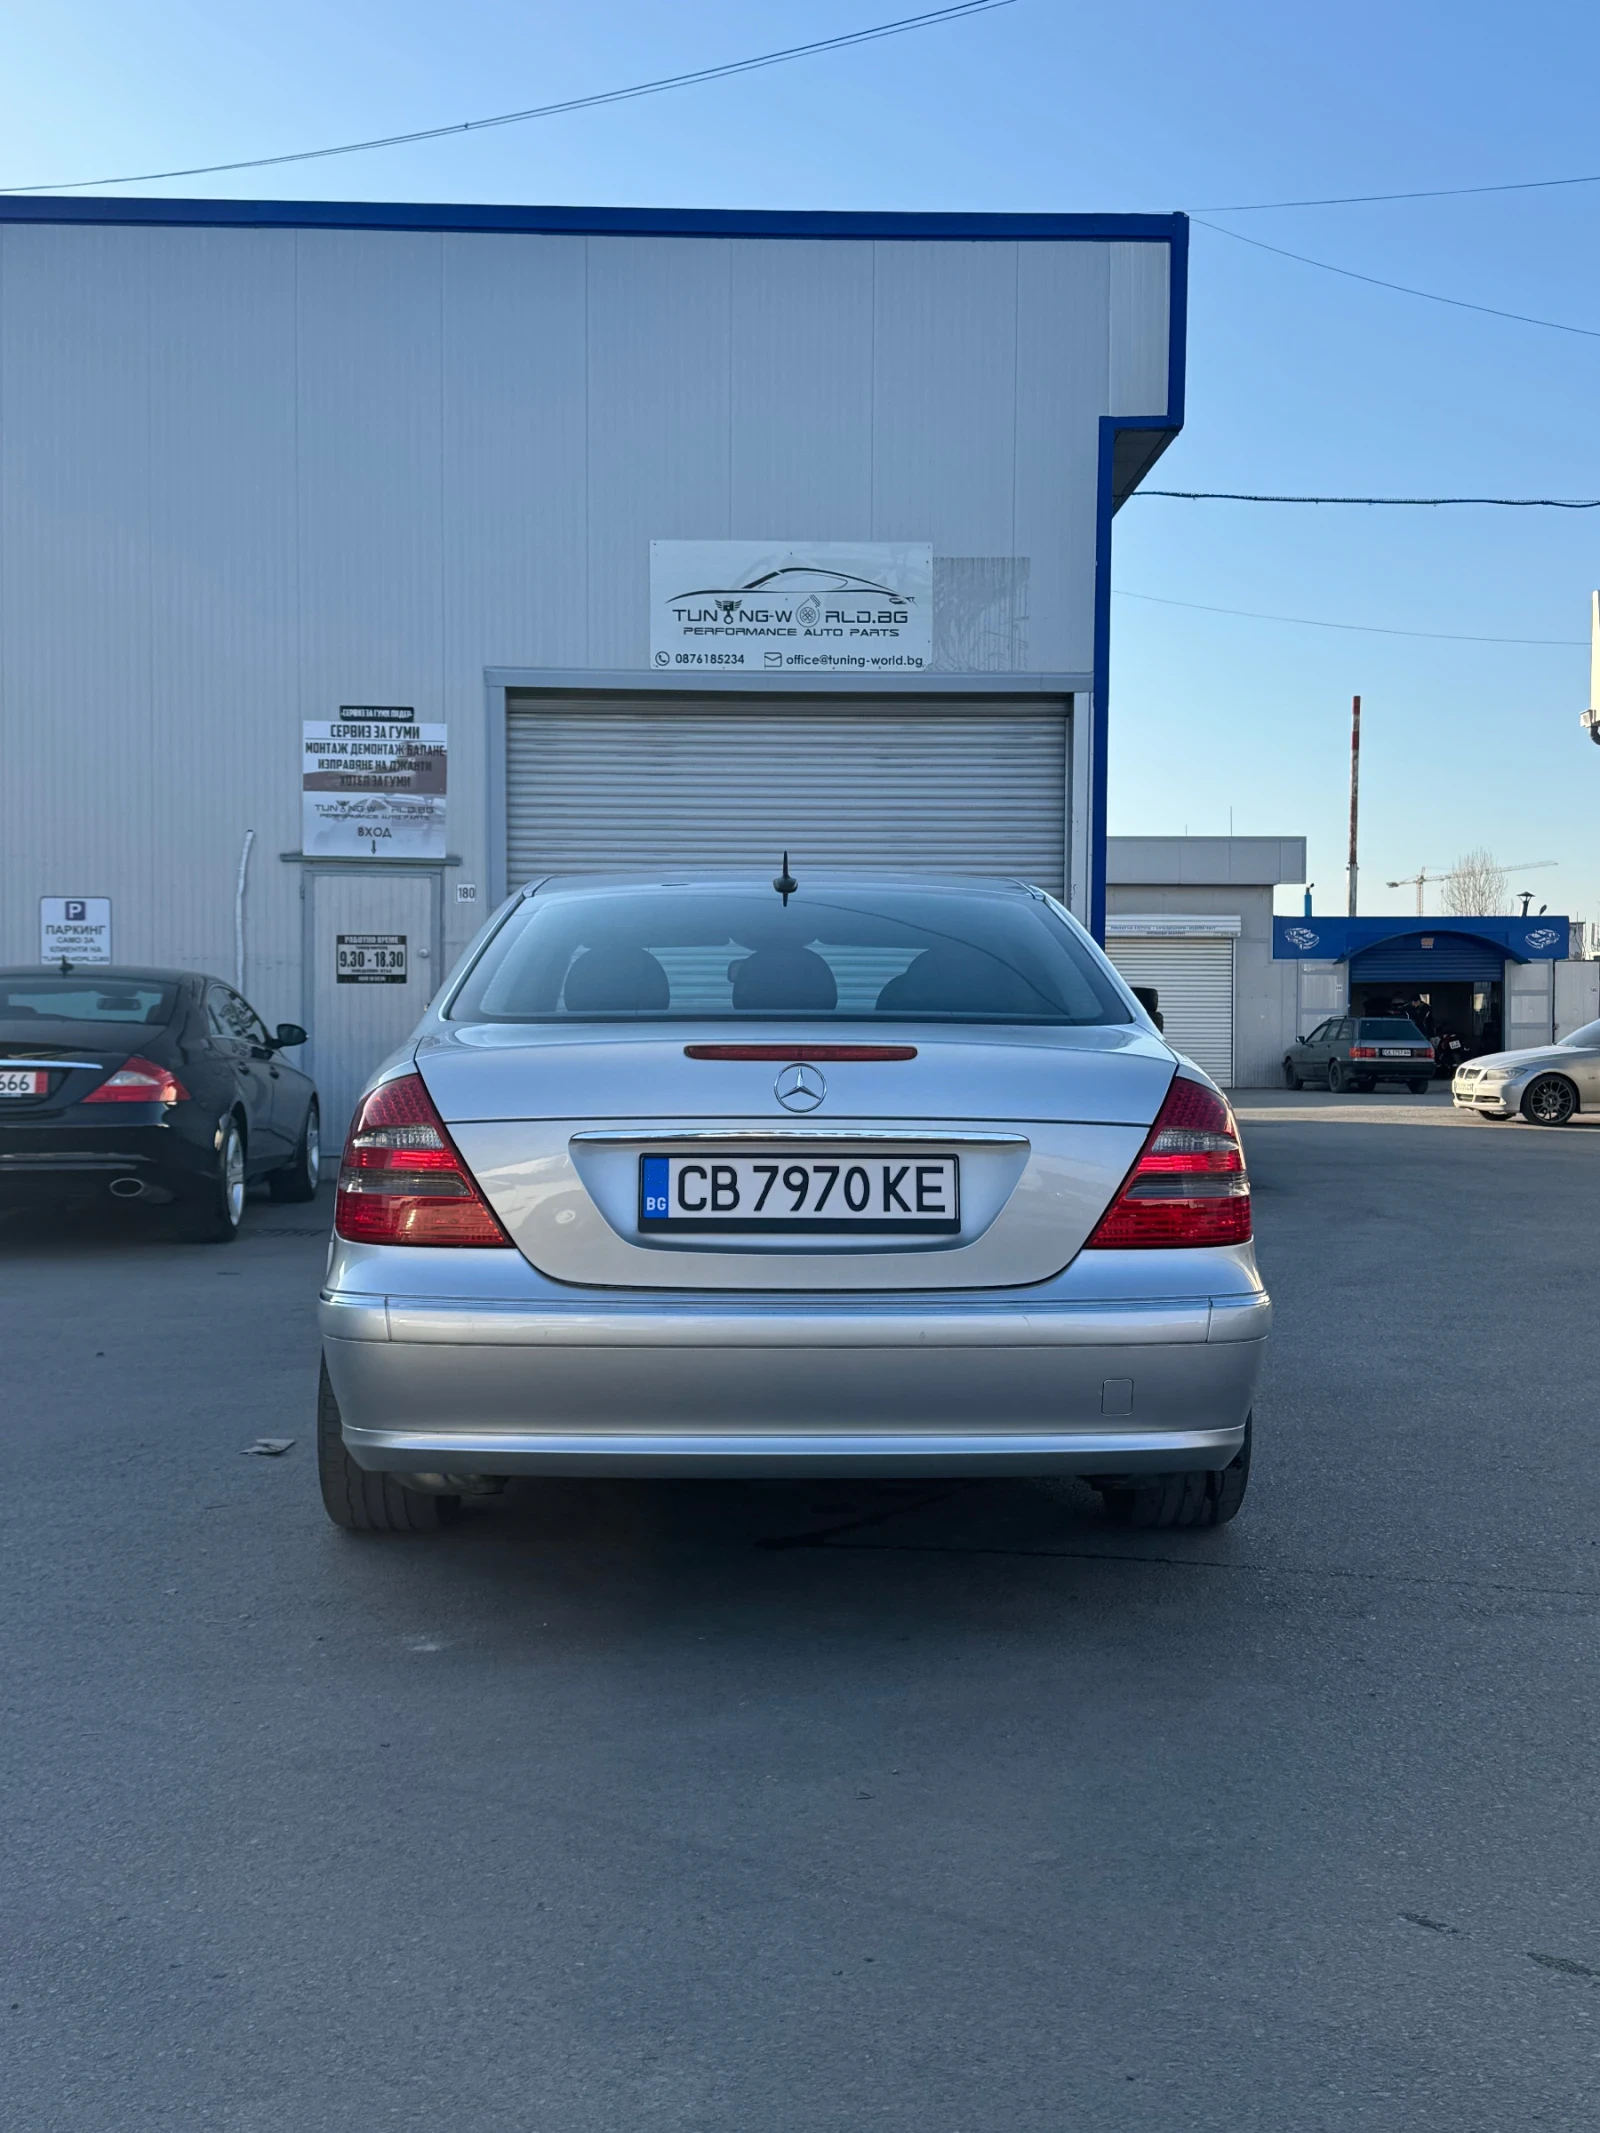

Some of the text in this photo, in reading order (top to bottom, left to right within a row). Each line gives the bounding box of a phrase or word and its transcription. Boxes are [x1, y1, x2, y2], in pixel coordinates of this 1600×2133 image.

[683, 627, 900, 637] PERFORMANCE AUTO PARTS
[675, 653, 745, 665] 0876185234
[786, 654, 923, 668] office@tuning-world.bg
[330, 725, 420, 739] СЕРВИЗ ЗА ГУМИ
[305, 742, 348, 755] МОНТАЖ
[350, 743, 405, 757] ДЕМОНТАЖ
[318, 759, 432, 773] ИЗПРАВЯНЕ НА ДЖАНТИ
[340, 775, 411, 788] ХОТЕЛ ЗА ГУМИ
[357, 827, 392, 838] ВХОД
[458, 887, 475, 899] 180
[46, 925, 106, 935] ПАРКИНГ
[340, 951, 365, 968] 9.30
[374, 951, 404, 968] 18.30
[0, 1074, 30, 1091] 666
[645, 1165, 946, 1212] BG CB 7970 KE
